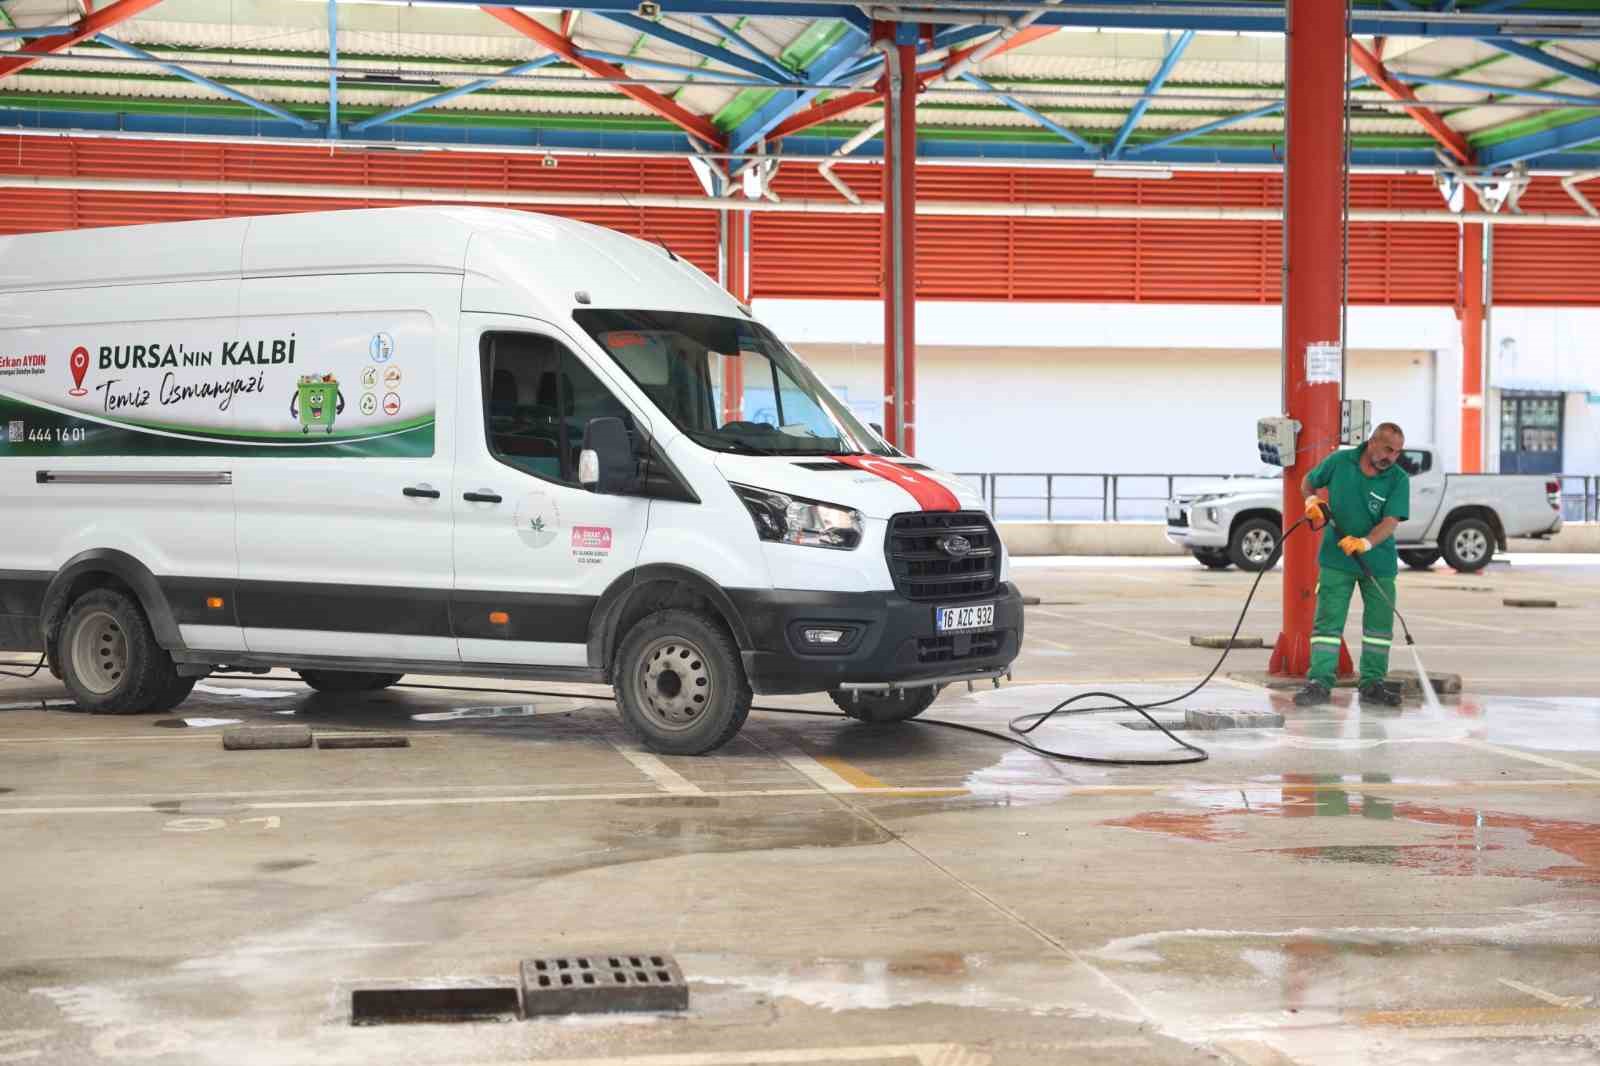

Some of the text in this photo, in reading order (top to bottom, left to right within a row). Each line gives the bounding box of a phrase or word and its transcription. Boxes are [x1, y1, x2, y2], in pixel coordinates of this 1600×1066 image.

[221, 333, 296, 366] KALBİ
[95, 371, 264, 412] Temiz Osmangazi
[28, 428, 51, 441] 444
[943, 606, 992, 628] 16 AZC 932
